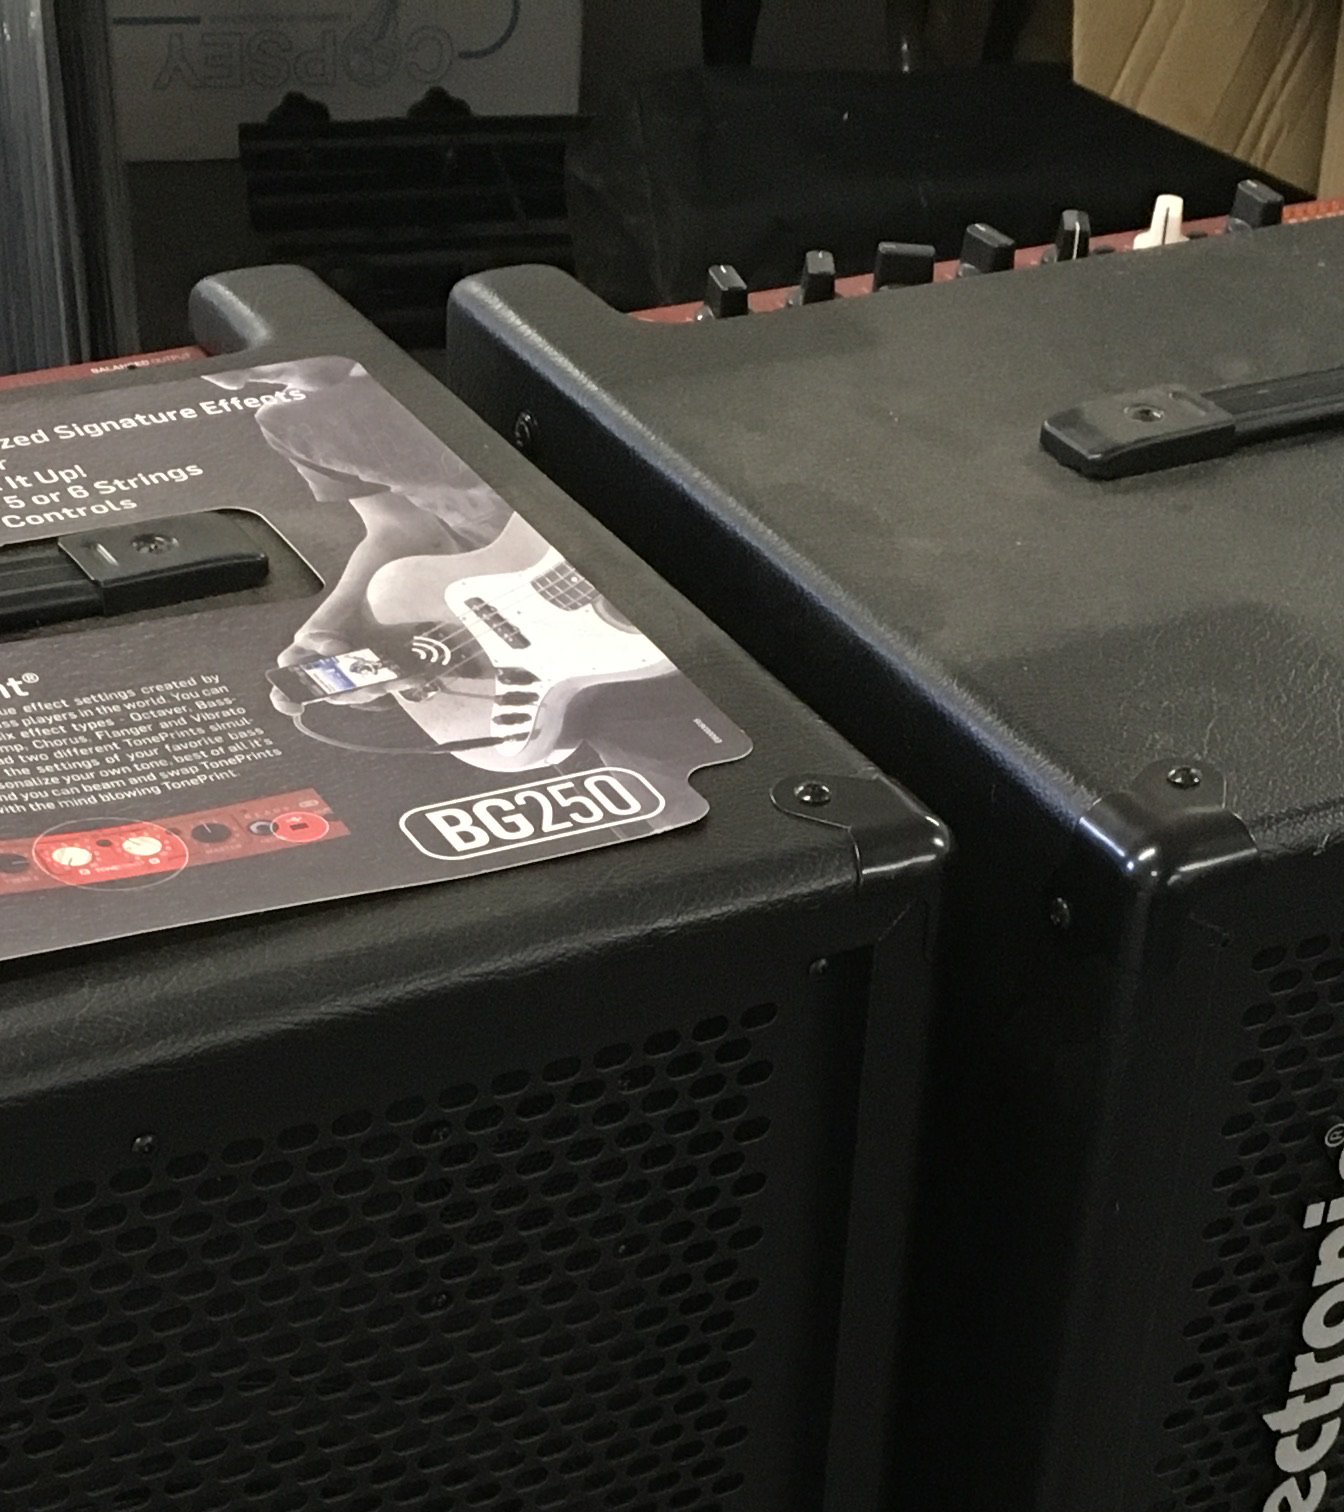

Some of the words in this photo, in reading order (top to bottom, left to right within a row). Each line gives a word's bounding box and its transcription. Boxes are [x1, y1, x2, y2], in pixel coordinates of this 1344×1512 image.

[54, 407, 198, 439] Signature
[199, 388, 307, 416] Effects
[3, 494, 26, 509] 5
[32, 491, 61, 506] or
[67, 484, 90, 499] 6
[94, 463, 204, 495] Strings
[5, 474, 33, 490] It
[33, 464, 89, 484] Up!
[1, 498, 137, 529] Controls
[21, 709, 77, 728] players
[79, 708, 94, 717] in
[95, 704, 122, 715] the
[123, 695, 169, 710] world.
[170, 691, 200, 702] You
[202, 685, 229, 696] can
[23, 699, 70, 713] effect
[74, 687, 136, 706] settings
[141, 677, 197, 695] created
[201, 673, 220, 684] by
[20, 724, 67, 738] effect
[71, 717, 115, 732] types
[129, 705, 193, 722] Octaver,
[195, 698, 236, 710] Bass-
[32, 734, 92, 749] Chorus,
[95, 724, 153, 740] Flanger
[159, 718, 187, 729] and
[190, 707, 246, 723] Vibrato
[3, 767, 31, 777] the
[36, 757, 100, 774] settings
[105, 753, 121, 764] of
[126, 748, 159, 762] your
[164, 735, 224, 752] favorite
[228, 727, 264, 741] bass
[18, 752, 49, 763] two
[53, 742, 121, 759] different
[122, 728, 205, 748] TonePrints
[61, 771, 95, 785] your
[99, 765, 132, 777] own
[134, 759, 174, 772] tone,
[173, 751, 208, 764] best
[210, 746, 225, 756] of
[227, 741, 248, 753] all
[20, 789, 49, 801] you
[51, 785, 80, 796] can
[81, 778, 127, 792] beam
[128, 772, 157, 785] and
[159, 764, 199, 779] swap
[200, 748, 283, 771] TonePrints
[29, 800, 56, 812] the
[57, 795, 98, 808] mind
[98, 784, 161, 802] blowing
[425, 775, 642, 852] BG250
